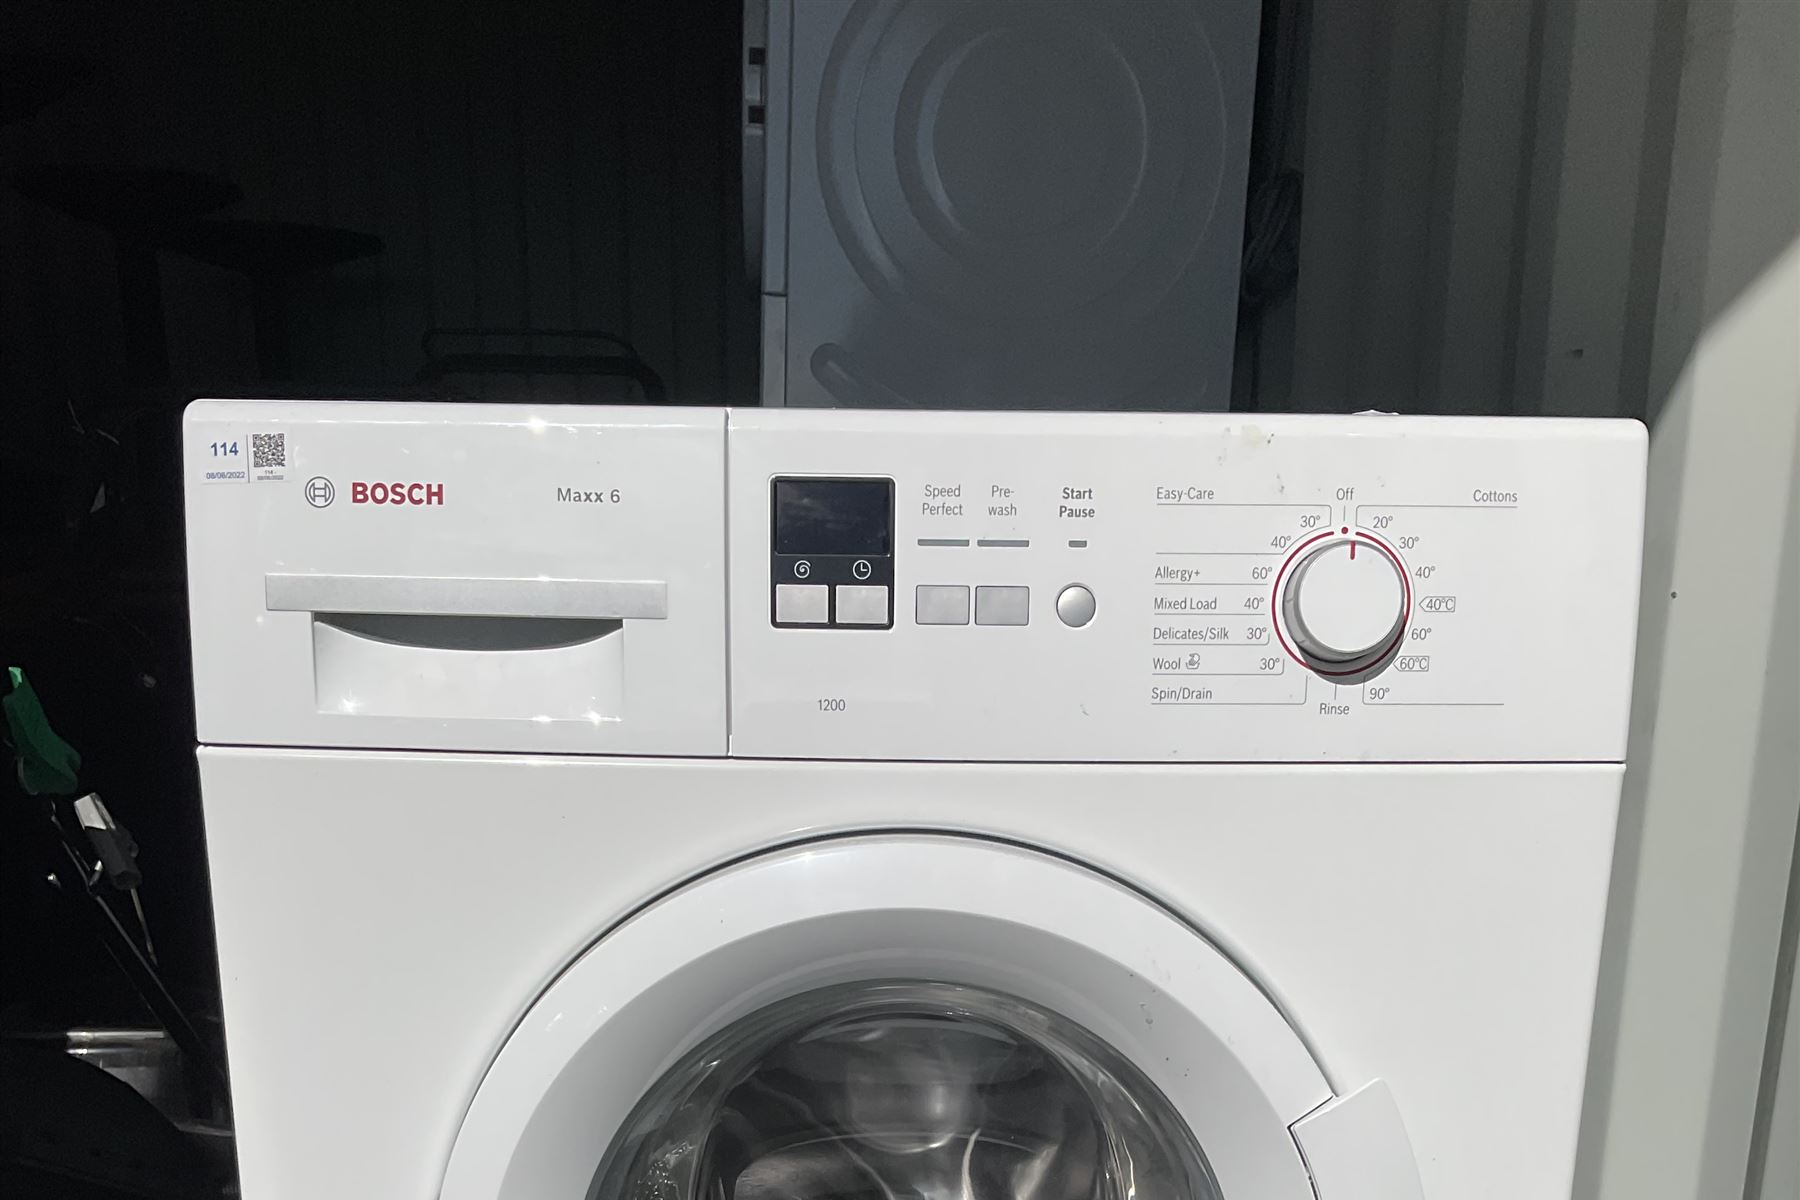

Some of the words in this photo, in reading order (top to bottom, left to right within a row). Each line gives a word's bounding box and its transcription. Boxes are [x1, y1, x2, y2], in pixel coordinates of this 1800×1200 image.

[210, 441, 239, 457] 114
[351, 481, 444, 506] BOSCH
[556, 487, 604, 504] Maxx
[610, 488, 621, 504] 6
[924, 484, 961, 499] Speed
[990, 485, 1015, 500] Pre-
[1062, 487, 1093, 500] Start
[1336, 487, 1354, 501] Off
[1472, 489, 1518, 503] Cottons
[921, 502, 963, 517] Perfect
[987, 503, 1017, 517] wash
[1058, 505, 1095, 520] Pause
[1300, 514, 1321, 528] 30°
[1373, 515, 1394, 529] 20°
[1270, 535, 1292, 549] 40°
[1399, 536, 1420, 550] 30°
[1154, 566, 1201, 582] Allergy+
[1251, 566, 1273, 580] 60°
[1415, 565, 1436, 579] 40°
[1153, 597, 1187, 610] Mixed
[1189, 597, 1218, 610] Load
[1243, 597, 1265, 610] 40°
[1426, 598, 1454, 611] 40°C
[1152, 627, 1230, 641] Delicates/Silk
[1246, 627, 1268, 641] 30°
[1411, 627, 1432, 641] 60°
[1152, 657, 1182, 671] Wool
[1259, 657, 1281, 671] 30°
[1399, 657, 1427, 670] 60°C
[1151, 686, 1213, 702] Spin/Drain
[1369, 687, 1390, 700] 90°
[817, 698, 846, 713] 1200
[1319, 701, 1350, 715] Rinse
